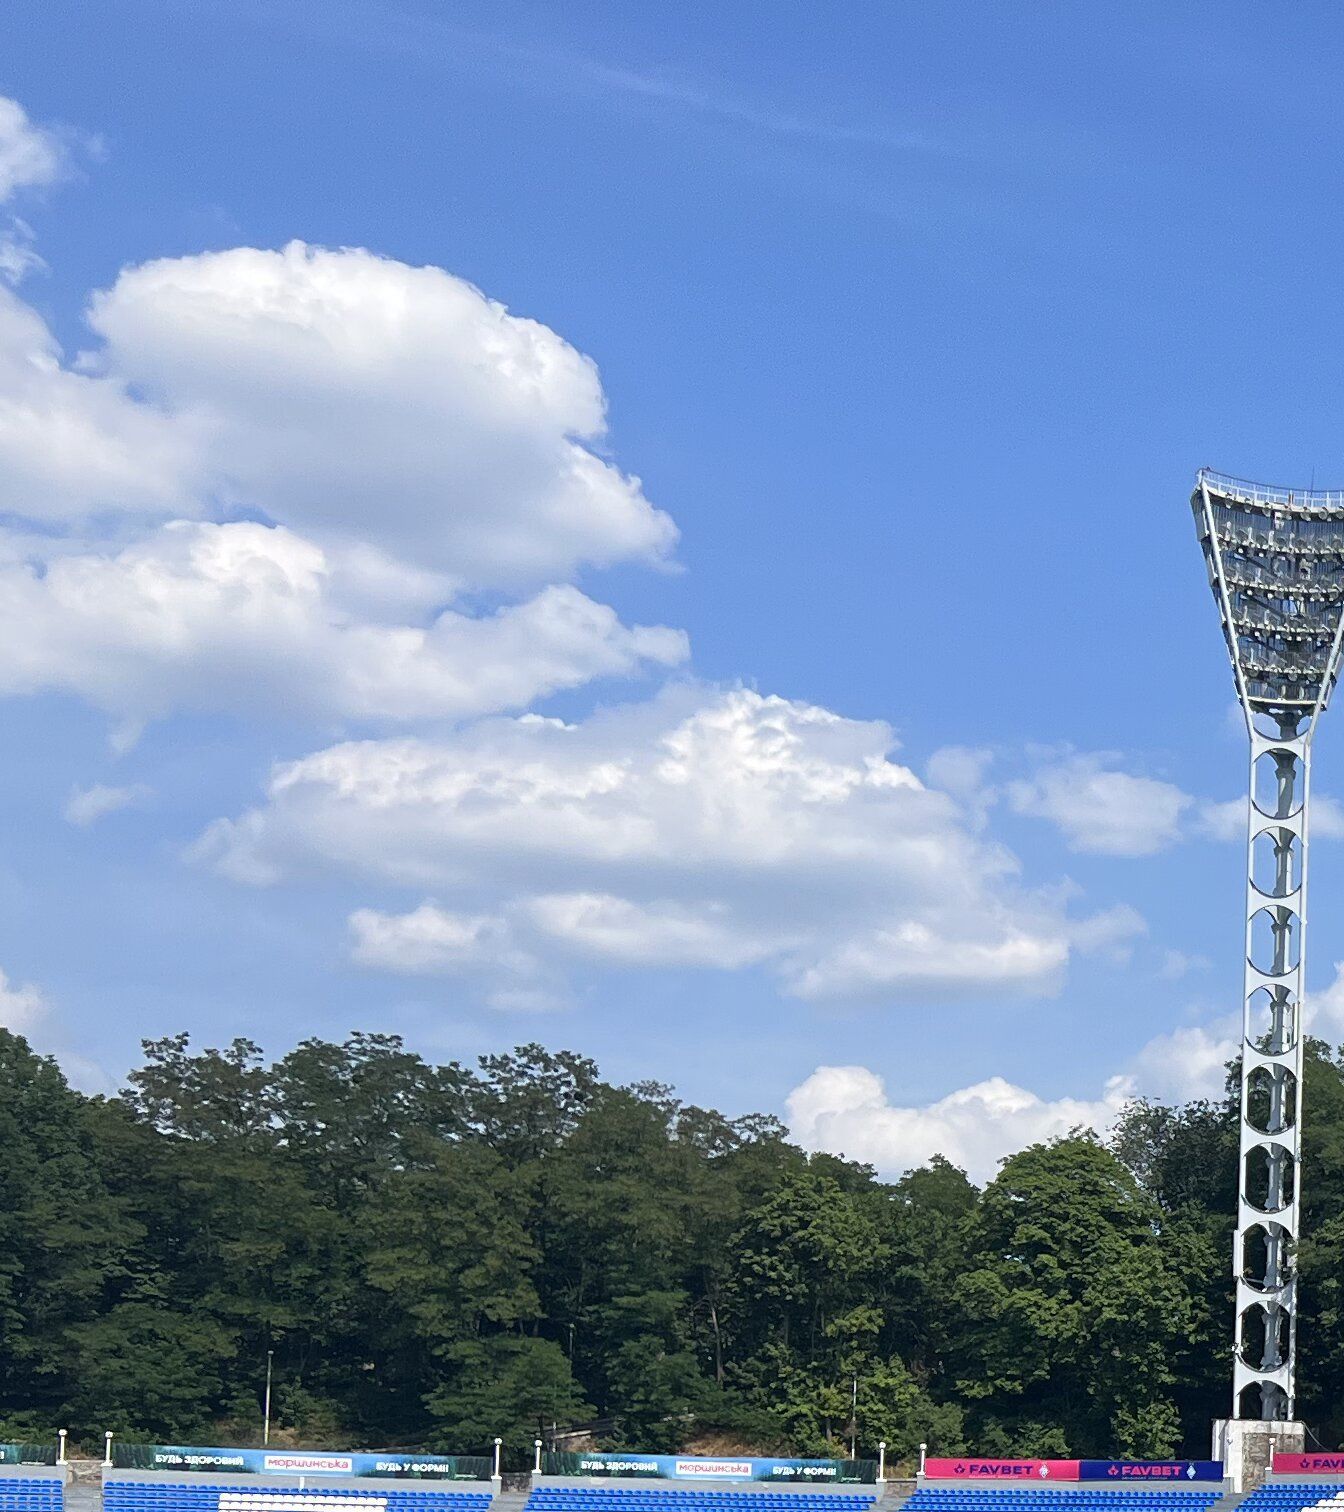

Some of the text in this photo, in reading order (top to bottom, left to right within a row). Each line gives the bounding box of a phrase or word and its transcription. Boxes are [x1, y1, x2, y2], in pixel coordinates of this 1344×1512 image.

[155, 1454, 244, 1466] БУДЬ ЗДОРОВИЙ
[375, 1461, 402, 1472] БУДЬ
[969, 1464, 1033, 1475] FAVBET
[1122, 1465, 1182, 1477] FAVBET
